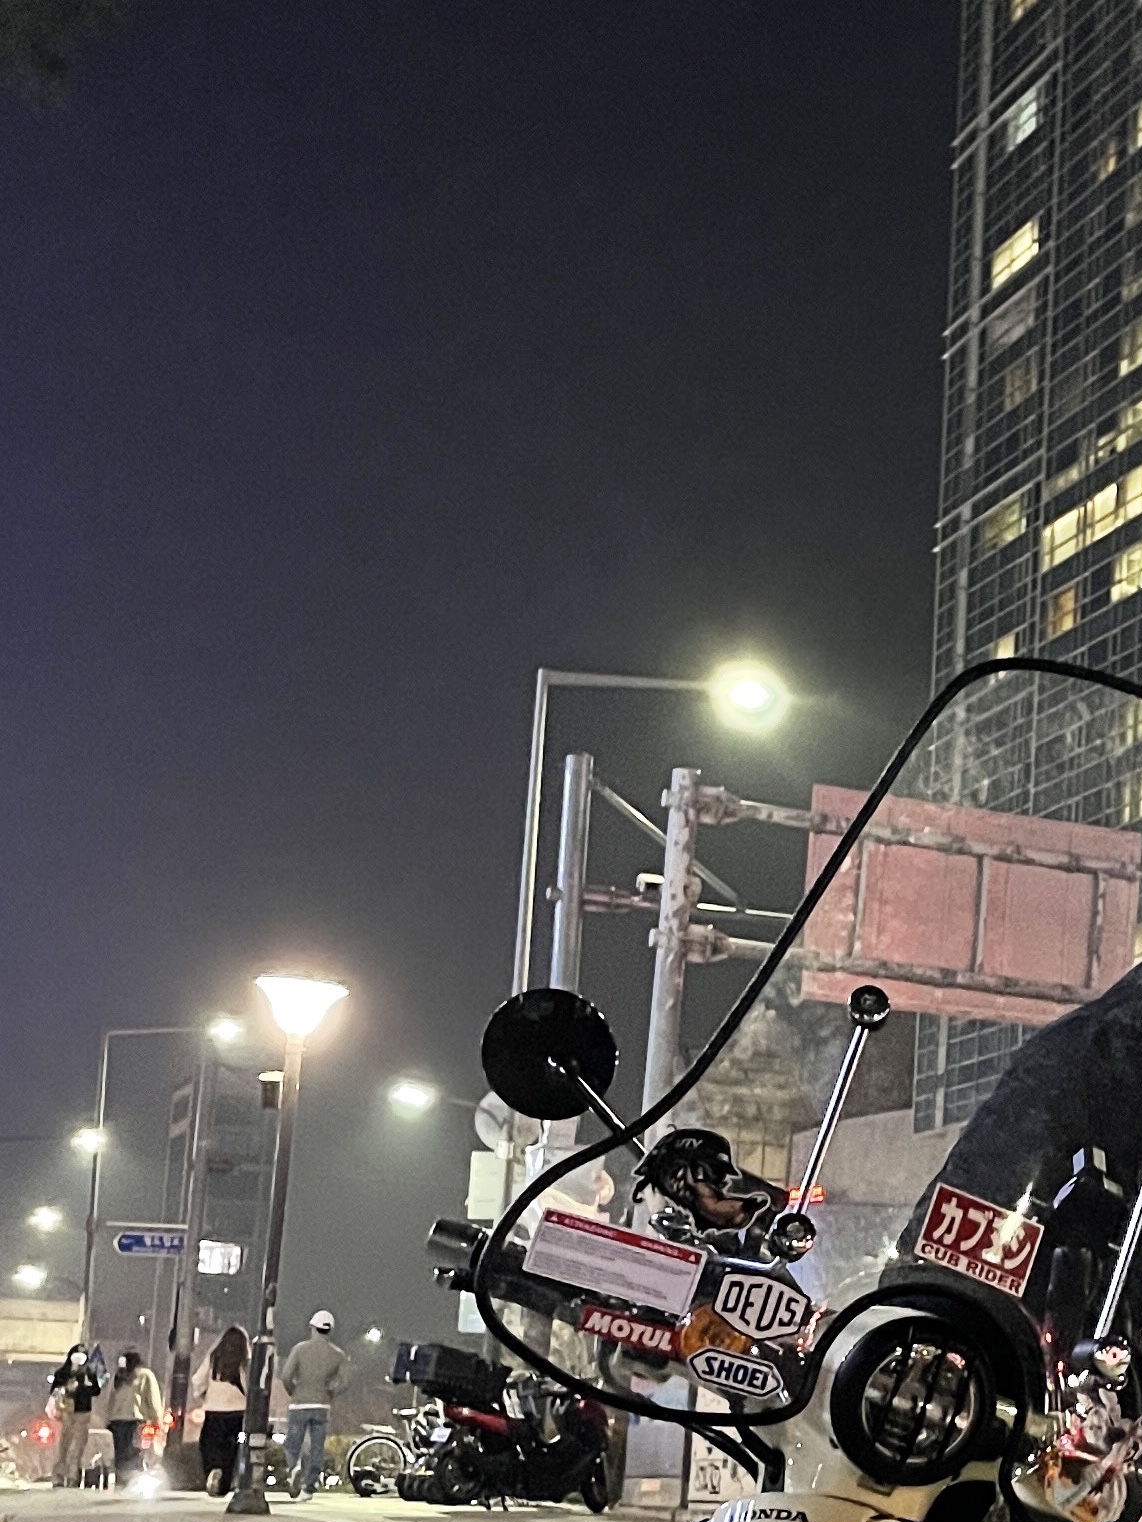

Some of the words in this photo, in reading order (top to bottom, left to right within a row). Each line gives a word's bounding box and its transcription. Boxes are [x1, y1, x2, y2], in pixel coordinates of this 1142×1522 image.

[920, 1242, 961, 1268] CUB
[965, 1261, 1023, 1295] RIDER
[721, 1280, 800, 1332] DEUS
[584, 1311, 673, 1352] MOTUL
[701, 1356, 769, 1391] SHOEI
